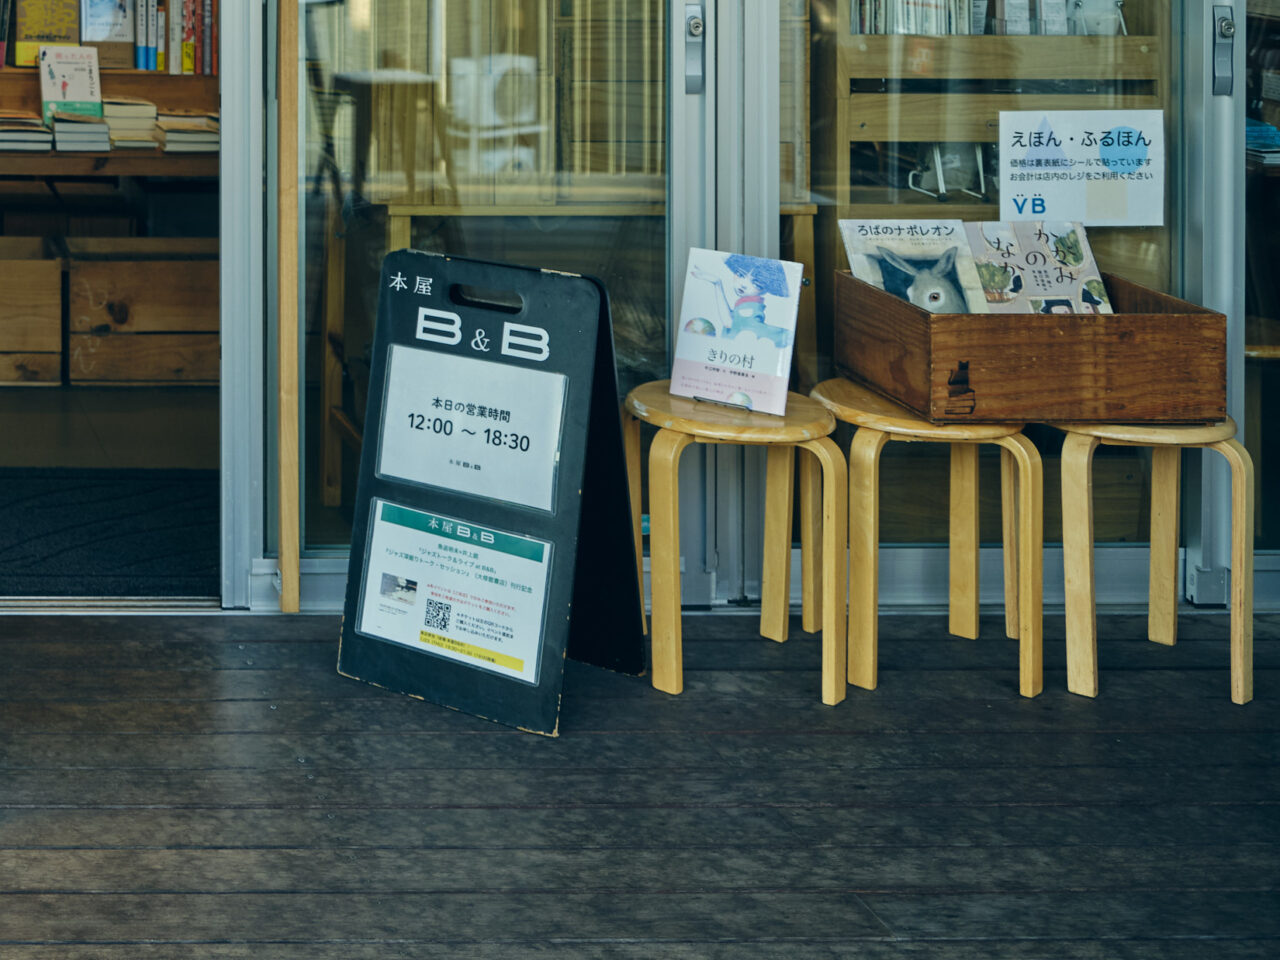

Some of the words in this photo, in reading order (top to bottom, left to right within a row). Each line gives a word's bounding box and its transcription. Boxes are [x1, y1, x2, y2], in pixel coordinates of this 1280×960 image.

[1011, 131, 1152, 148] えほん・ふるほん
[1010, 158, 1153, 167] 価格は裏表紙にシールで貼っています
[1010, 172, 1154, 181] お会計は店内のレジをご利用ください
[858, 224, 955, 236] ろばのナポレオン
[388, 271, 433, 296] 本屋
[707, 348, 755, 370] きりの村
[432, 396, 511, 423] 本日の営業時間
[407, 413, 454, 436] 12:00
[483, 428, 530, 453] 18:30
[428, 517, 453, 534] 本屋
